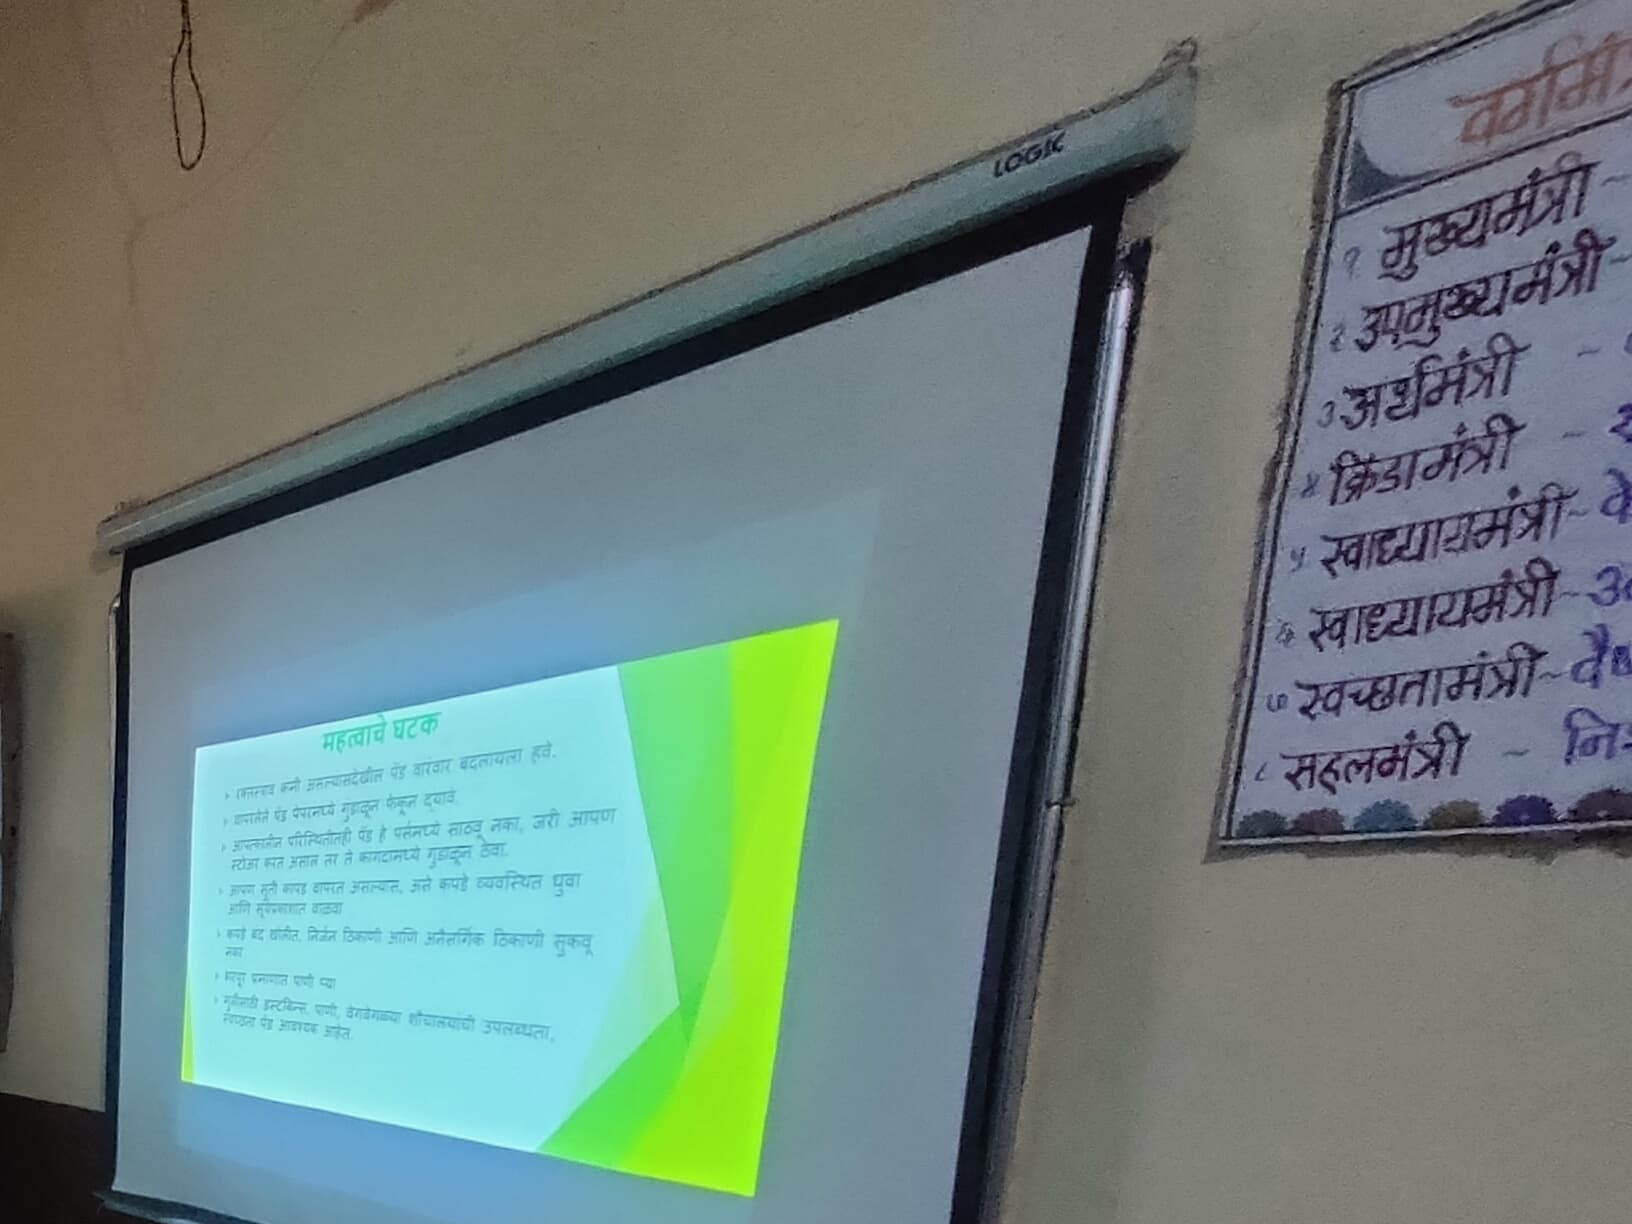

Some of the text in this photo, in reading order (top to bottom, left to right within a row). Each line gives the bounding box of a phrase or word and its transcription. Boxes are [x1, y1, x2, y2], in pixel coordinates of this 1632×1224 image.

[993, 129, 1067, 178] LOGIC
[1377, 150, 1602, 282] मुख्यमंत्री
[1354, 227, 1617, 352] उपमुख्यमंत्री
[1294, 642, 1548, 721] स्वच्छतामंत्री
[393, 712, 441, 740] घटक
[459, 749, 523, 771] बदलायला
[1280, 721, 1470, 795] सहलमंत्री
[1564, 707, 1632, 766] नि
[533, 808, 561, 830] जरी
[569, 807, 617, 828] आपण
[439, 873, 468, 892] कपडे
[476, 870, 544, 892] व्यवस्थित
[552, 873, 583, 897] धुवा
[388, 928, 418, 944] आणि
[493, 928, 544, 948] ठिकाणी
[553, 934, 595, 958] सुकवू
